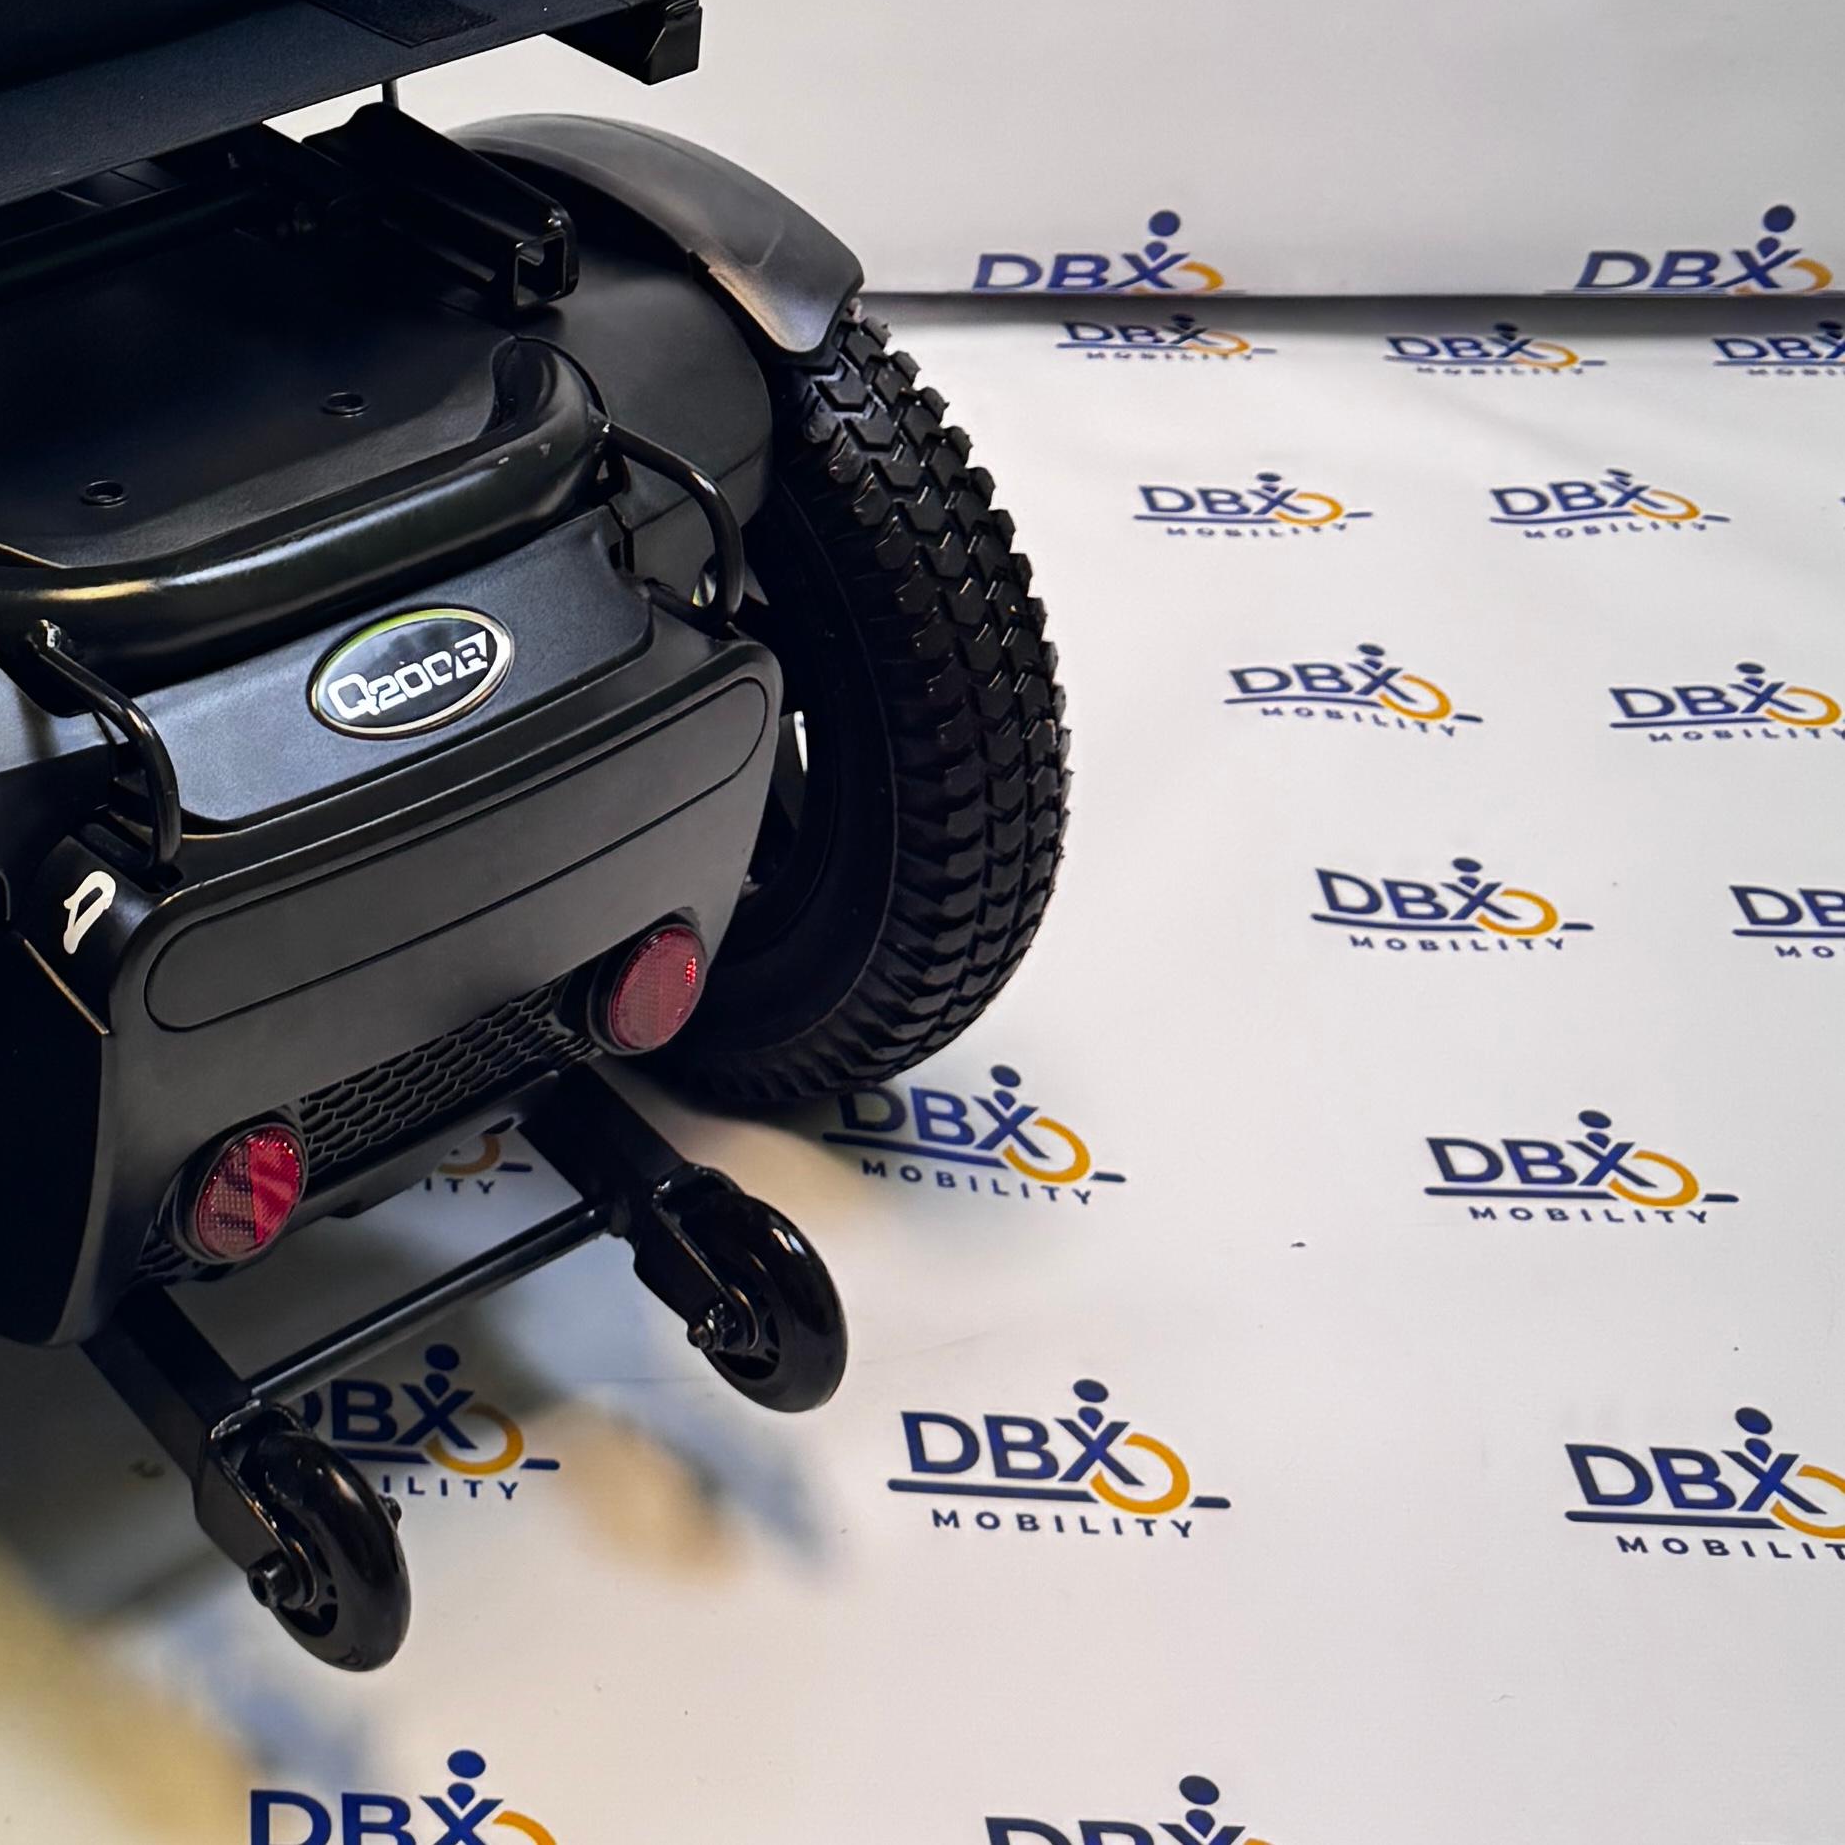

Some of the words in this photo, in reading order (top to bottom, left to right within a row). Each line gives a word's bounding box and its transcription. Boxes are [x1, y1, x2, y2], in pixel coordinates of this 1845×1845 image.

[973, 253, 1189, 289] DBX
[1575, 249, 1801, 289] DBX
[1138, 485, 1306, 522] DBX
[1491, 481, 1677, 518] DBX
[1165, 522, 1349, 538] MOBILITY
[1523, 520, 1708, 539] MOBILITY
[1228, 663, 1419, 702] DBX
[1609, 682, 1806, 718] DBX
[1261, 706, 1456, 737] MOBILITY
[1314, 867, 1518, 921] DBX
[1729, 885, 1845, 926] DB
[1350, 935, 1566, 952] MOBILITY
[839, 1086, 1049, 1158] DBX
[1425, 1134, 1659, 1191] DBX
[863, 1159, 1091, 1205] MOBILITY
[1468, 1204, 1710, 1226] MOBILITY
[302, 1380, 477, 1449] BX
[899, 1411, 1143, 1487] DBX
[383, 1475, 517, 1499] ILITY
[1565, 1444, 1828, 1515] DBX
[931, 1507, 1196, 1540] MOBILITY
[1617, 1536, 1845, 1559] MOBILIT
[251, 1789, 503, 1845] DBX
